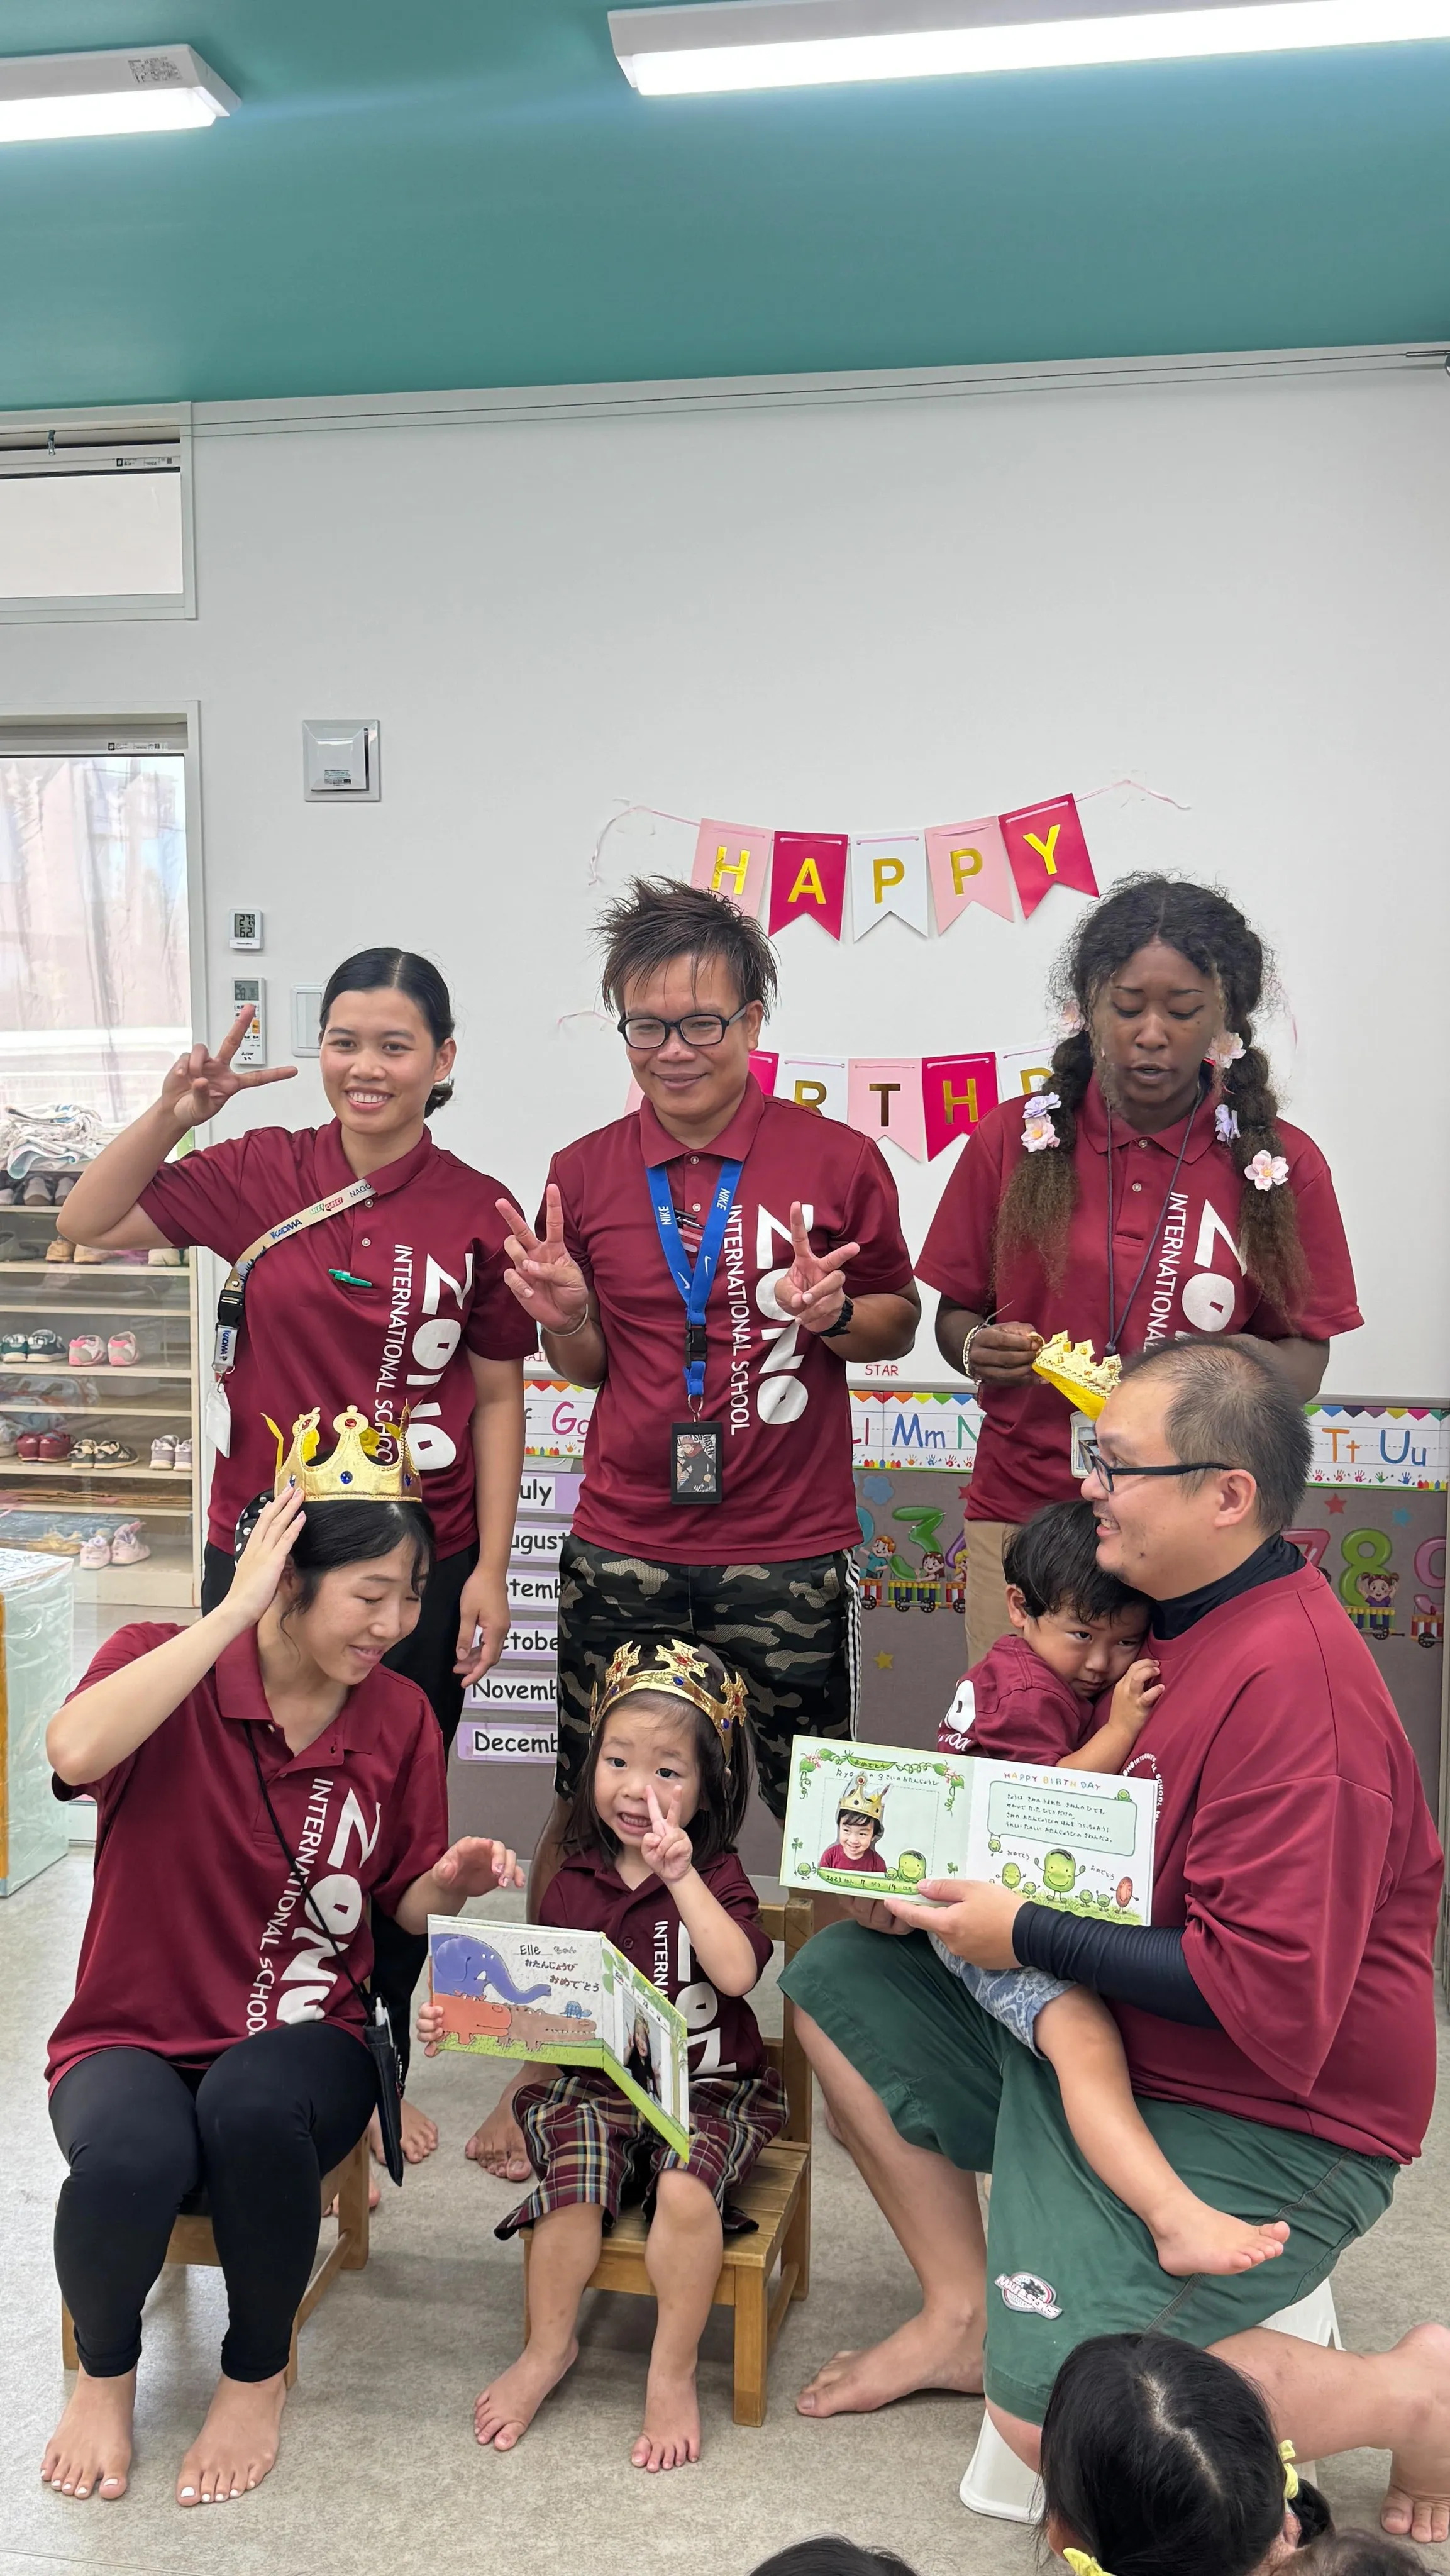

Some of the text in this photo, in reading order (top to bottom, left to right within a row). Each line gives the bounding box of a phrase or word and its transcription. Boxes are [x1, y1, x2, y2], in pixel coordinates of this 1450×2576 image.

[711, 824, 1061, 908] HAPPY
[716, 1187, 731, 1211] NIKE
[659, 1205, 673, 1226] NIKE
[1143, 1192, 1189, 1351] INTERNATIONA
[724, 1204, 751, 1436] INTERNATIONAL SCHOOL
[373, 1243, 414, 1463] INTERNATIONAL SCHOO
[865, 1364, 899, 1376] STAR
[892, 1413, 946, 1449] Mm
[1322, 1428, 1360, 1463] Tt
[1380, 1429, 1427, 1467] Uu
[520, 1479, 552, 1506] uly
[473, 1679, 556, 1701] Novemb
[475, 1731, 558, 1753] Decemb
[1004, 1772, 1038, 1782] HAPPY
[246, 1777, 334, 2036] INTERNATIONAL SCHOO
[276, 1787, 382, 2025] ZONO
[519, 1944, 541, 1955] Elle
